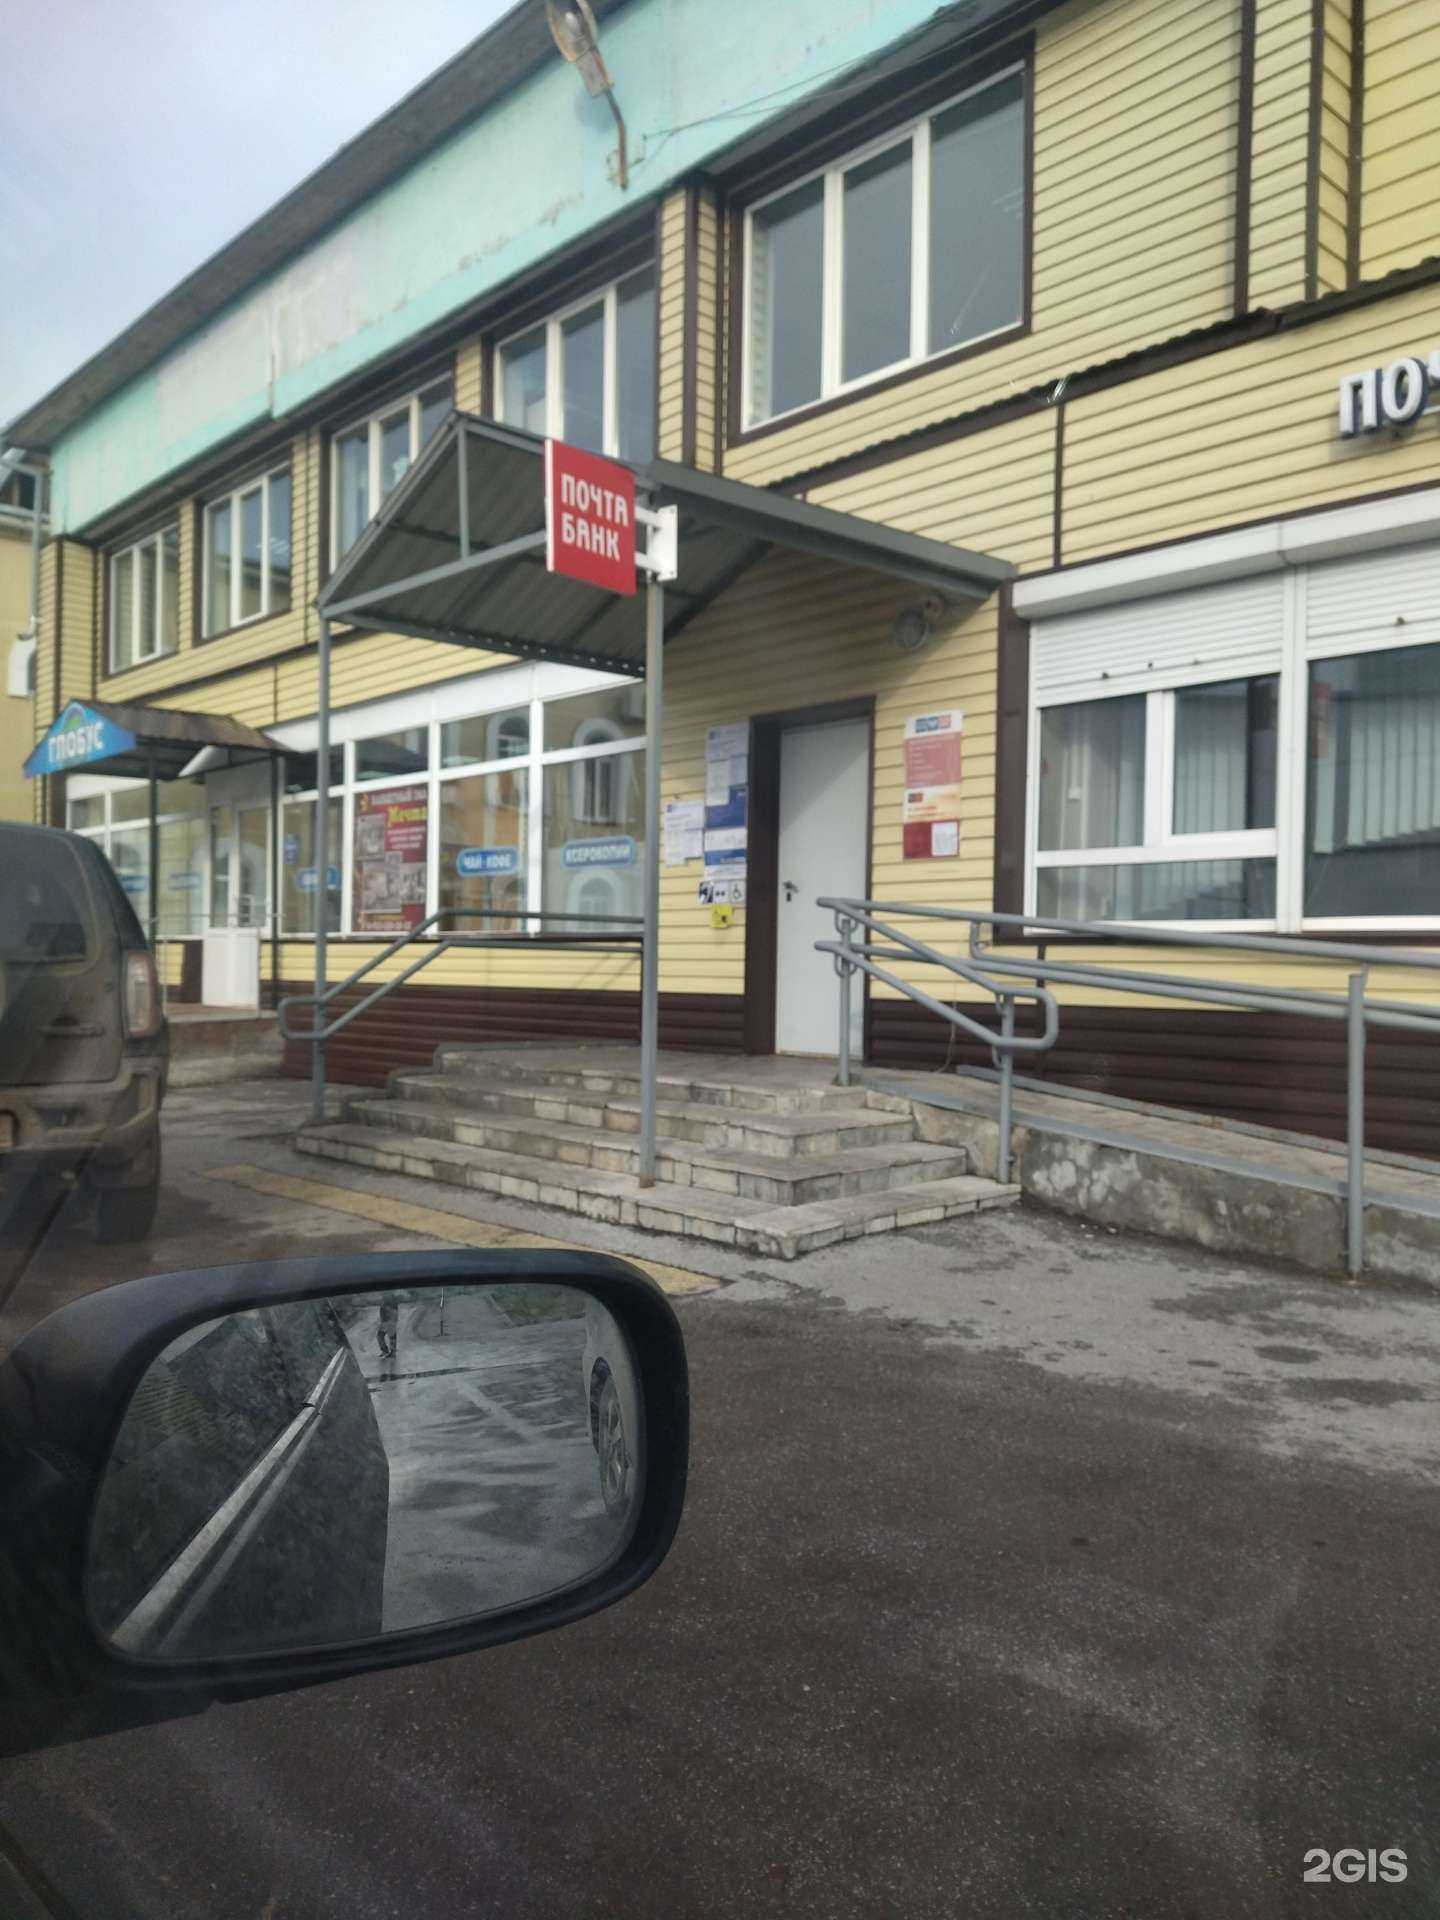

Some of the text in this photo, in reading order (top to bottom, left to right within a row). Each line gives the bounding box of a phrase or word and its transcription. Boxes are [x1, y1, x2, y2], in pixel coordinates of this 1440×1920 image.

[560, 472, 628, 527] ПОЧТА
[561, 513, 621, 562] БАНК
[48, 721, 105, 763] ГЛОБУС
